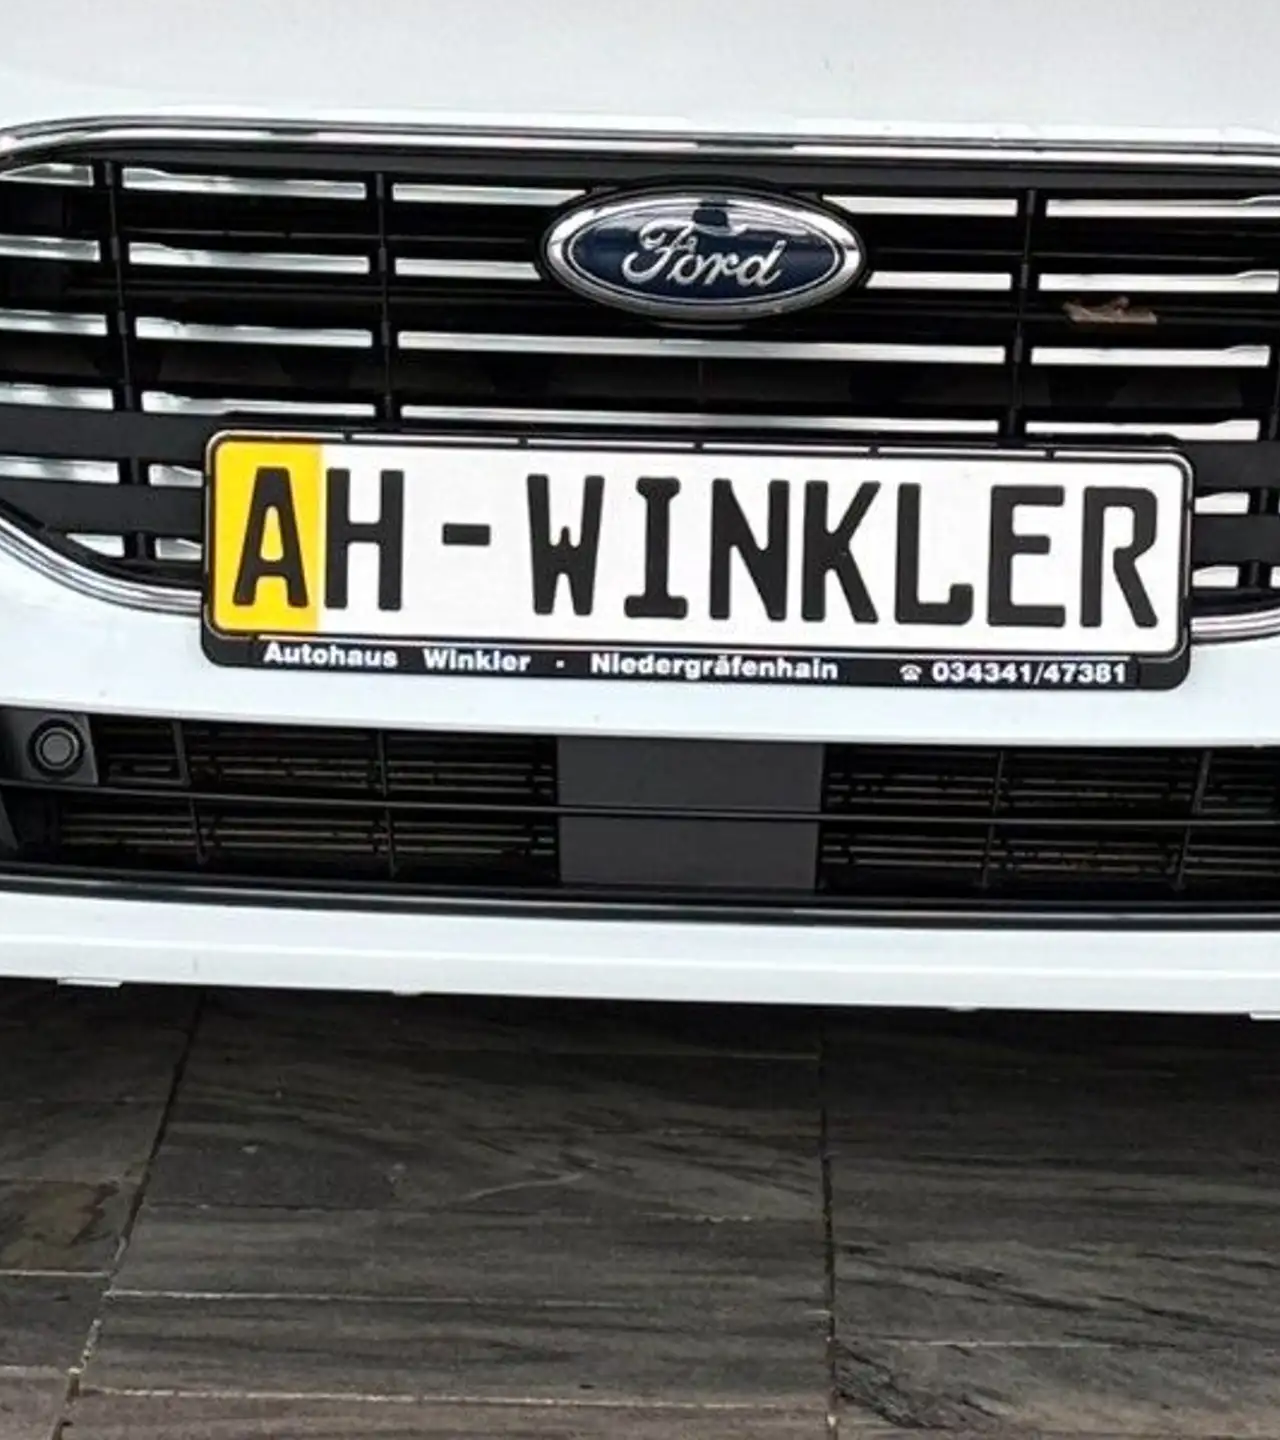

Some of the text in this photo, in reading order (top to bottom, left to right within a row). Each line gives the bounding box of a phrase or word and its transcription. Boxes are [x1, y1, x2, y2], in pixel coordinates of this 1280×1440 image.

[622, 218, 787, 287] Ford
[232, 466, 1158, 629] AH-WINKLER
[263, 641, 1127, 684] Autohaus Winkler Niedergräfenhain 034341/47381
